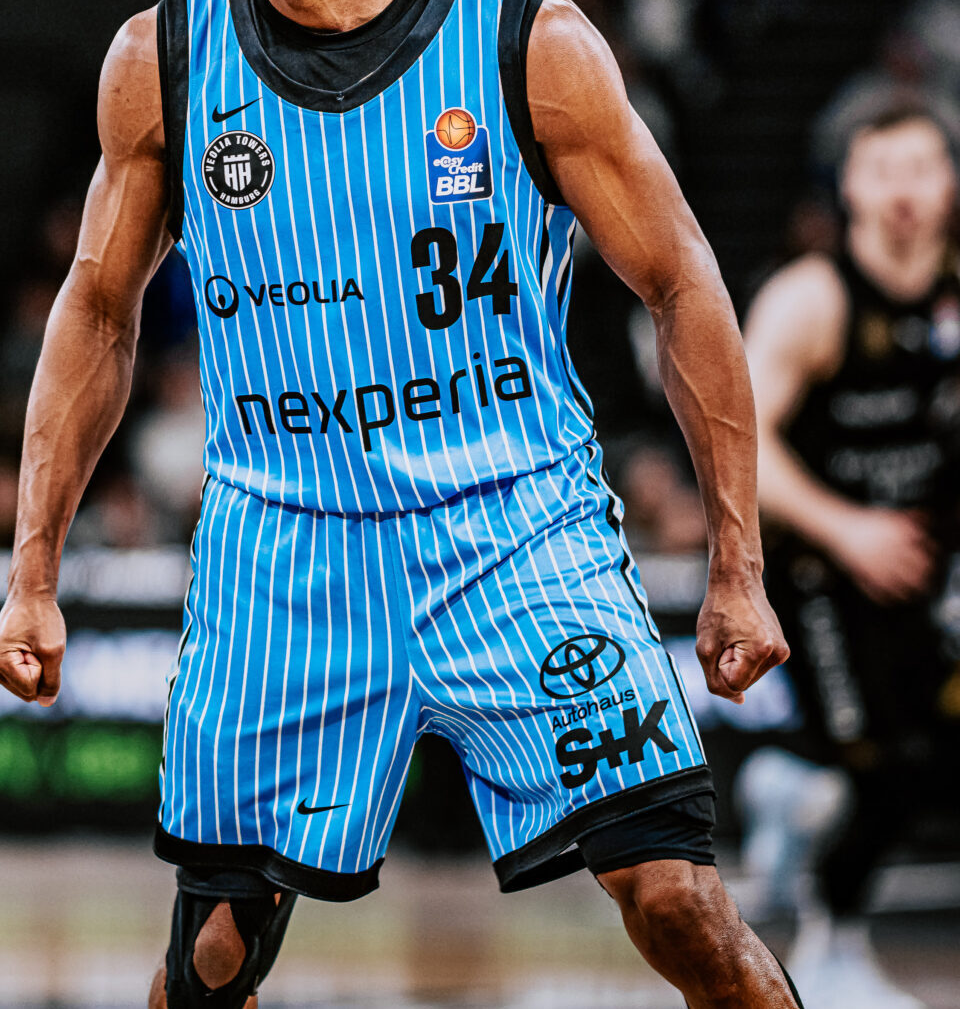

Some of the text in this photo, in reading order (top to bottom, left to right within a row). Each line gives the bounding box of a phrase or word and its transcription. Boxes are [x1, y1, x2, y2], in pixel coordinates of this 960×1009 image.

[205, 135, 271, 172] VEOLIA TOWERS
[448, 162, 484, 175] Credit
[219, 189, 261, 205] HAMBURG
[435, 173, 485, 197] BBL
[243, 277, 365, 307] VEOLIA
[410, 223, 519, 331] 34
[236, 351, 532, 452] nexperia
[552, 688, 636, 733] Autohaus
[555, 699, 679, 790] S+K
